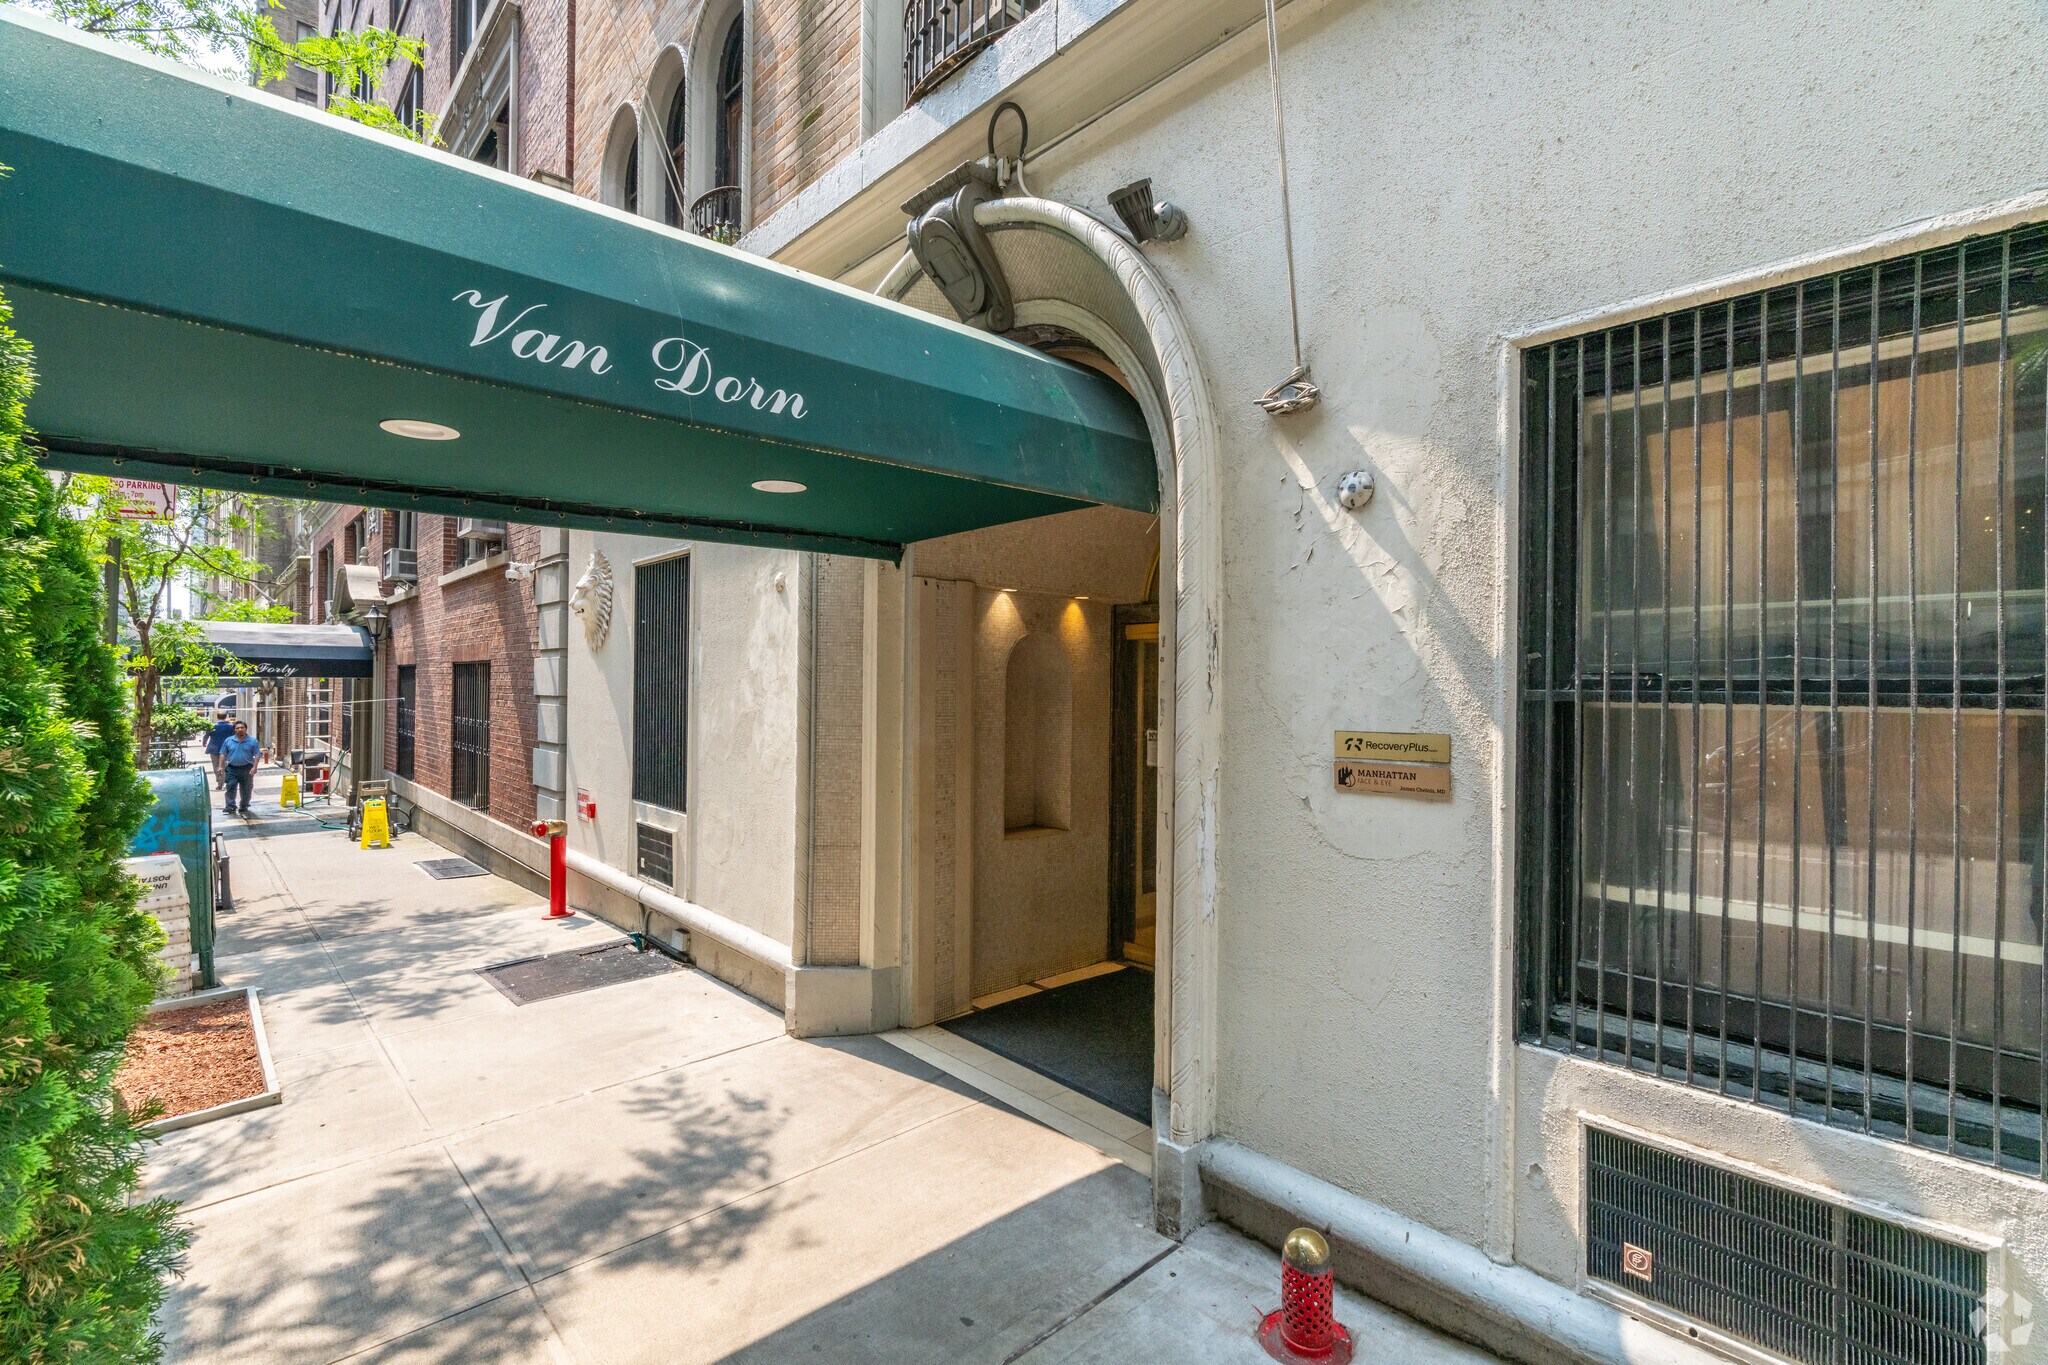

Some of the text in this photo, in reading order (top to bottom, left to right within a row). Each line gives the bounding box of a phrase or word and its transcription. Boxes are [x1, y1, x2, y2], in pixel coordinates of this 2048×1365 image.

[452, 289, 808, 419] Van Dorn
[126, 480, 162, 490] PARKING
[255, 662, 299, 677] Forty
[1365, 740, 1429, 753] RecoveryPlus
[1357, 769, 1417, 781] MANHATTAN
